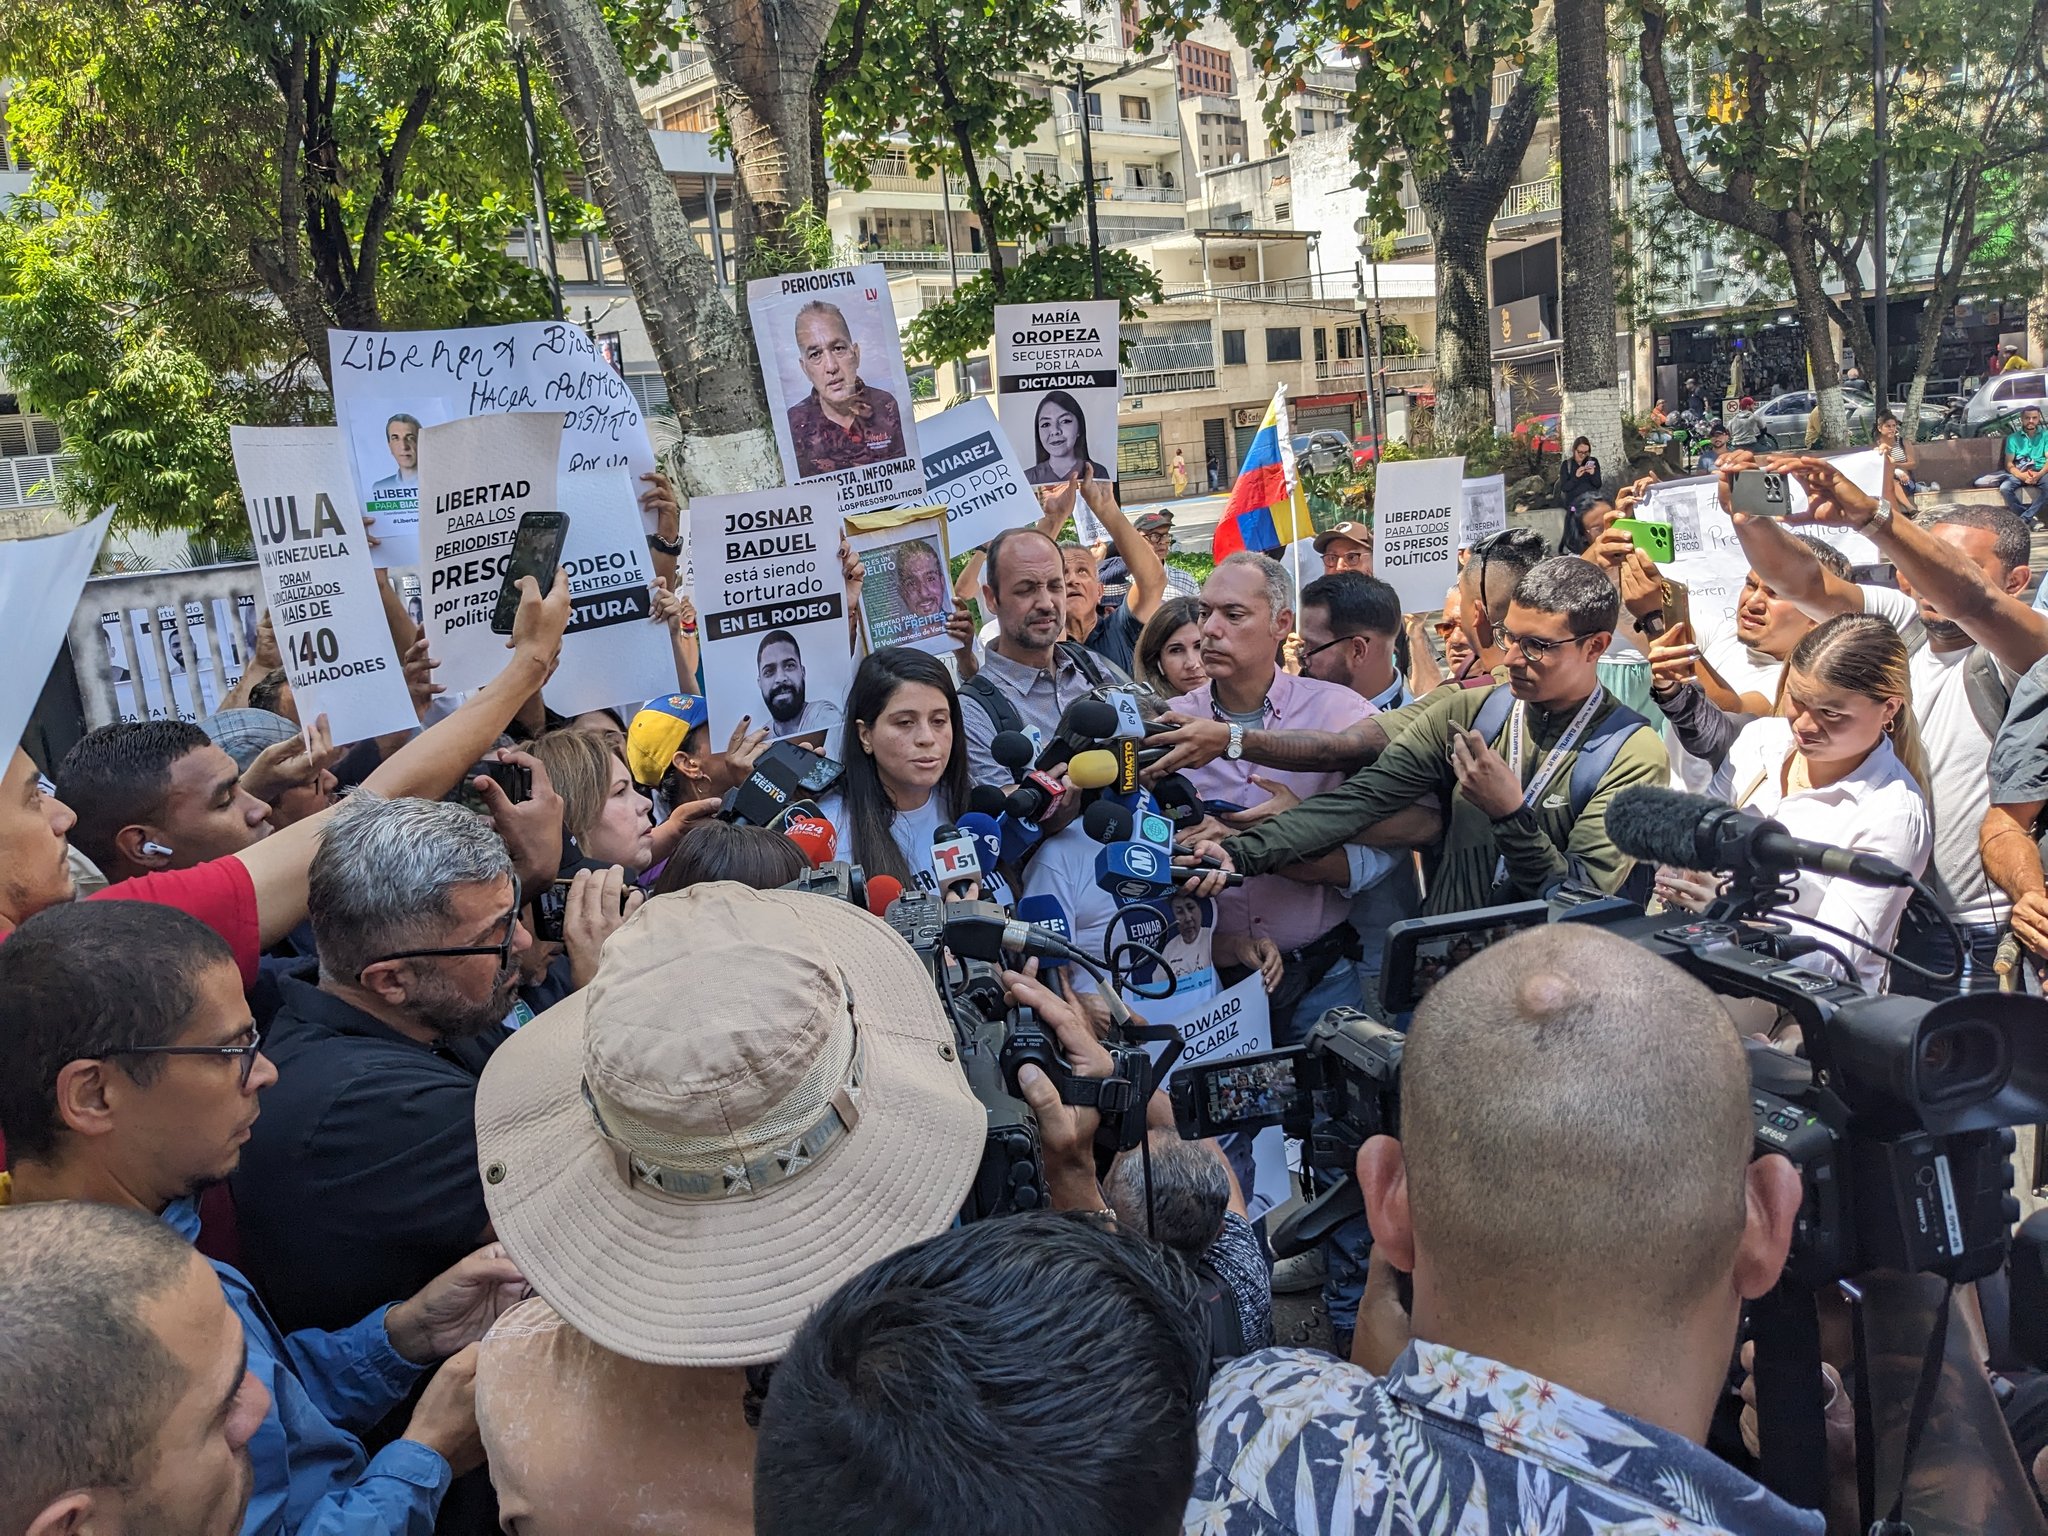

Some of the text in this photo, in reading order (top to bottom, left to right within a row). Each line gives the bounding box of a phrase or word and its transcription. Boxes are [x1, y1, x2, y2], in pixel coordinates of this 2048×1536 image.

[782, 271, 856, 295] PERIODISTA
[865, 288, 878, 301] LV
[1032, 309, 1080, 324] MARÍA
[1012, 328, 1100, 344] OROPEZA
[1012, 348, 1103, 361] SECUESTRADA
[1036, 360, 1080, 371] POR LA
[1019, 375, 1096, 389] DICTADURA
[863, 459, 916, 479] INFORMAR
[925, 441, 994, 480] LVIAREZ
[969, 464, 1011, 491] POR
[436, 480, 531, 514] LIBERTAD
[839, 488, 922, 513] LOSPRESOSPOLITICOS
[843, 486, 855, 501] ES
[857, 479, 893, 497] DELITO
[375, 502, 399, 510] PARA
[946, 482, 1018, 523] DISTINTO
[253, 493, 347, 546] LULA
[447, 507, 516, 532] PARA LOS
[725, 505, 812, 532] JOSNAR
[1385, 507, 1451, 523] LIBERDADE
[1385, 522, 1449, 537] PARA TODOS
[272, 542, 350, 566] VENEZUELA
[726, 533, 816, 560] BADUEL
[1384, 535, 1449, 552] OS PRESOS
[629, 550, 638, 566] I
[871, 558, 880, 566] ES
[1385, 549, 1449, 567] POLÍTICOS
[279, 571, 311, 586] FORAM
[624, 569, 643, 582] DE
[724, 560, 816, 584] está siendo
[723, 576, 823, 606] torturado
[282, 600, 332, 623] MAIS DE
[434, 589, 498, 620] por razo
[720, 602, 831, 634] EN EL RODEO
[871, 613, 918, 630] LIBERTAD PARA
[872, 612, 946, 639] JUAN FREITES
[288, 627, 340, 671] 140
[881, 632, 922, 647] Voluntariado
[1123, 741, 1134, 791] IMPACTO
[956, 853, 976, 868] 51
[1032, 918, 1065, 932] FE:
[1183, 1020, 1239, 1060] OCARIZ
